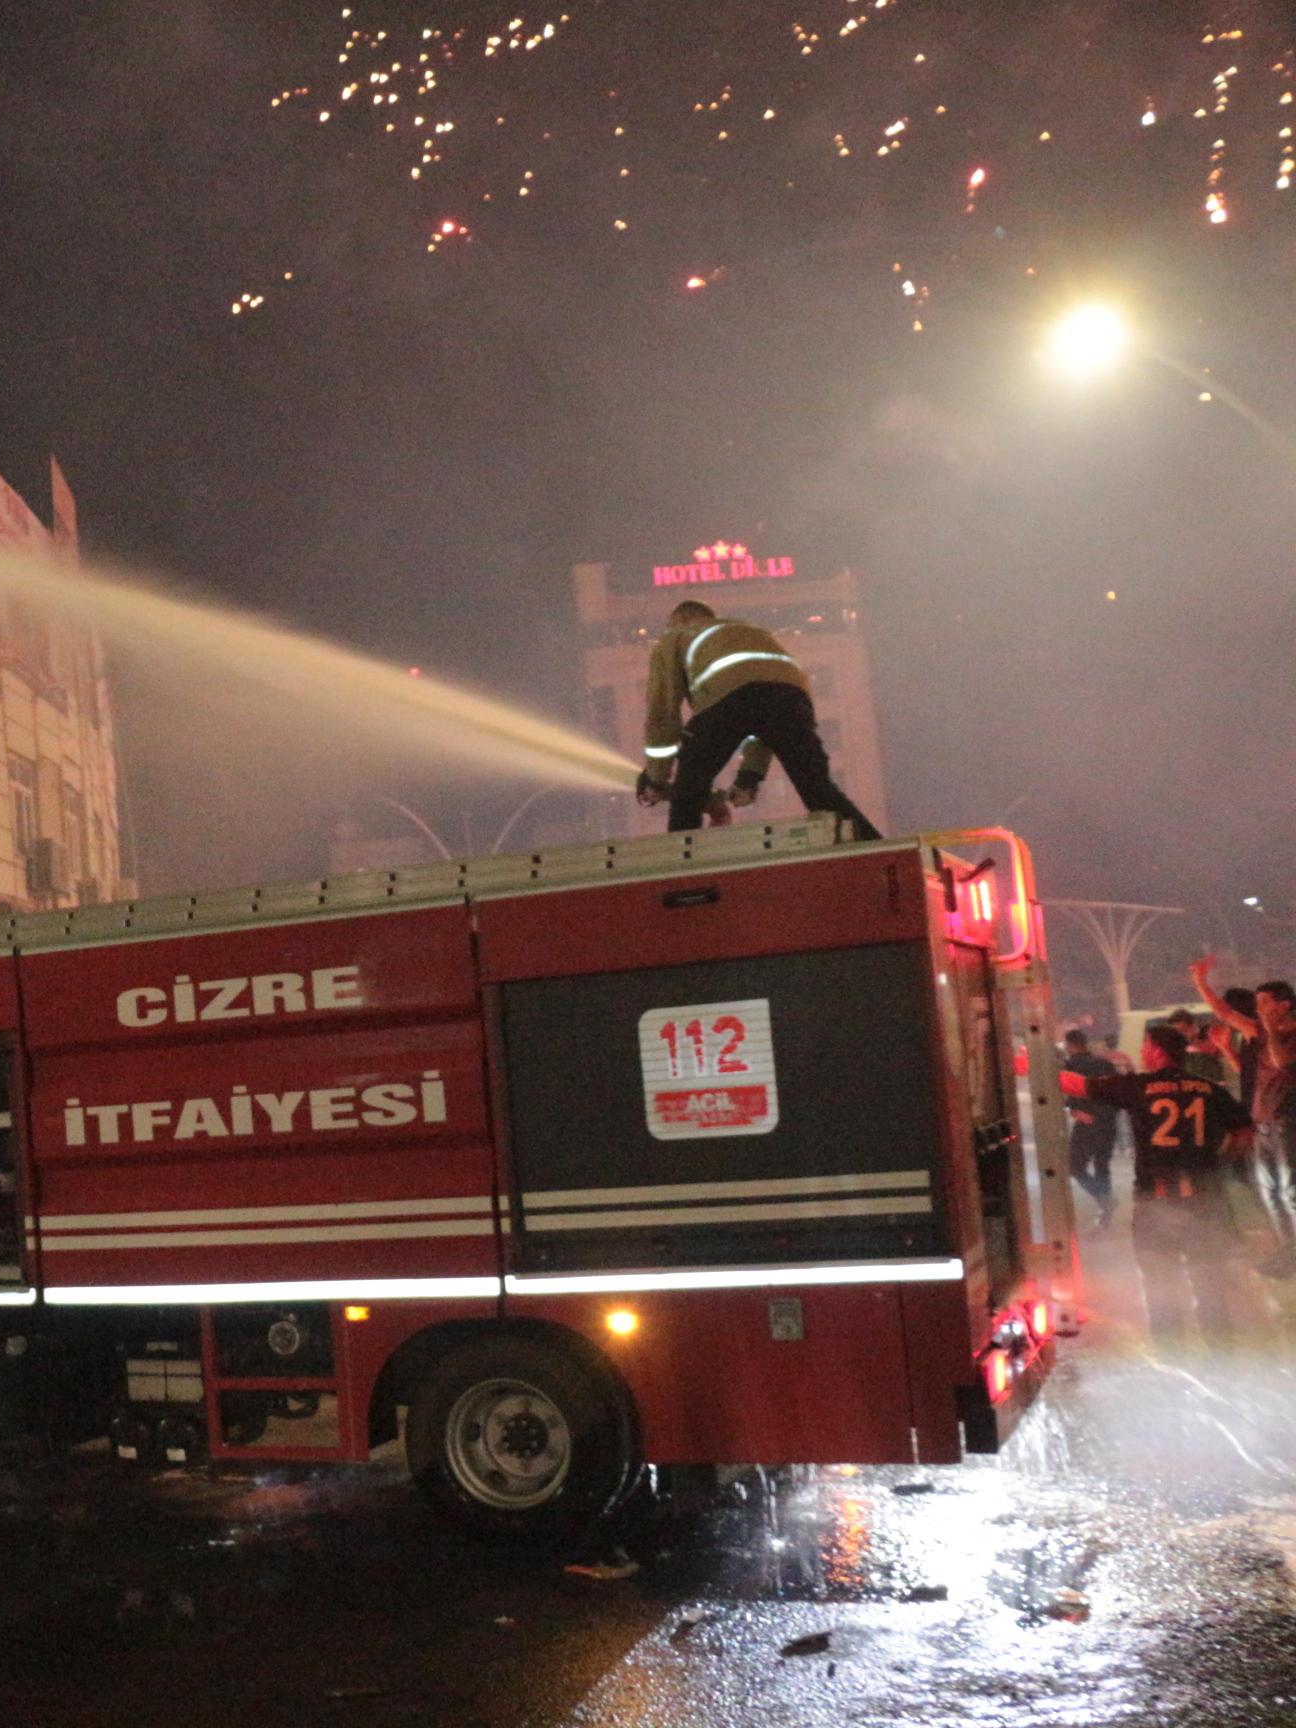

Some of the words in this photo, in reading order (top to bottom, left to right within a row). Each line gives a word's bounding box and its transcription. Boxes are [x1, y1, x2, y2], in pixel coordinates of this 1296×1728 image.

[653, 563, 726, 586] HOTEL
[116, 965, 364, 1028] CİZRE
[659, 1014, 750, 1078] 112
[63, 1069, 448, 1147] İTFAİYESİ
[1150, 1097, 1205, 1147] 21
